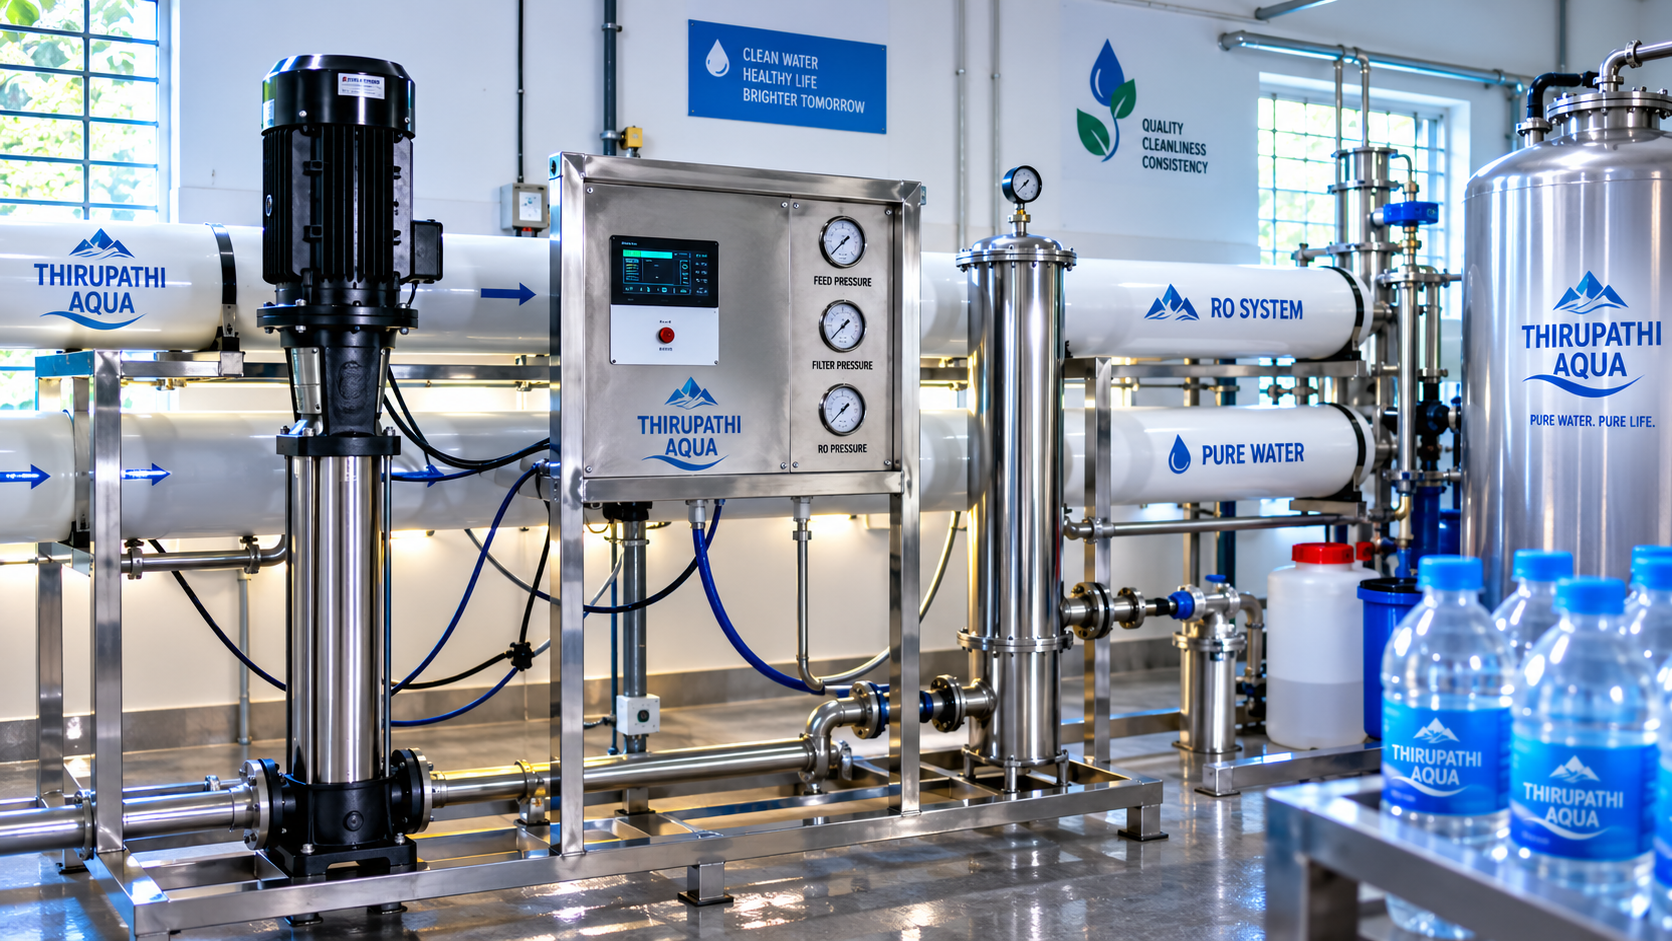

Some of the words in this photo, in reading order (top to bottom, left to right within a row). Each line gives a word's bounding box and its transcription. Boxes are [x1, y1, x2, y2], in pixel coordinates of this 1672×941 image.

[743, 47, 778, 65] CLEAN
[782, 52, 819, 70] WATER
[743, 67, 792, 86] HEALTHY
[796, 73, 818, 90] LIFE
[743, 87, 798, 107] BRIGHTER
[801, 94, 866, 114] TOMORROW
[1142, 117, 1184, 136] QUALITY
[1142, 136, 1208, 157] CLEANLINESS
[1142, 155, 1209, 174] CONSISTENCY
[33, 263, 166, 289] THIRUPATHI
[813, 275, 833, 286] FEED
[834, 276, 872, 287] PRESSURE
[68, 290, 136, 316] AQUA
[1210, 297, 1235, 319] RO
[1239, 298, 1304, 320] SYSTEM
[1521, 321, 1662, 349] THIRUPATHI
[812, 360, 835, 370] FILTER
[836, 360, 873, 371] PRESSURE
[1552, 351, 1628, 380] AQUA
[636, 415, 741, 435] THIRUPATHI
[1530, 414, 1555, 427] PURE
[1557, 414, 1596, 427] WATER.
[1598, 415, 1627, 428] PURE
[1629, 415, 1656, 428] LIFE.
[664, 437, 718, 459] AQUA
[817, 444, 829, 454] RO
[830, 443, 868, 454] PRESSURE
[1202, 443, 1246, 466] PURE
[1249, 441, 1305, 465] WATER
[1391, 743, 1482, 767] THIRUPATHI
[1410, 765, 1460, 786] AQUA
[1522, 781, 1625, 809] THIRUPATHI
[1545, 806, 1600, 828] AQUA
